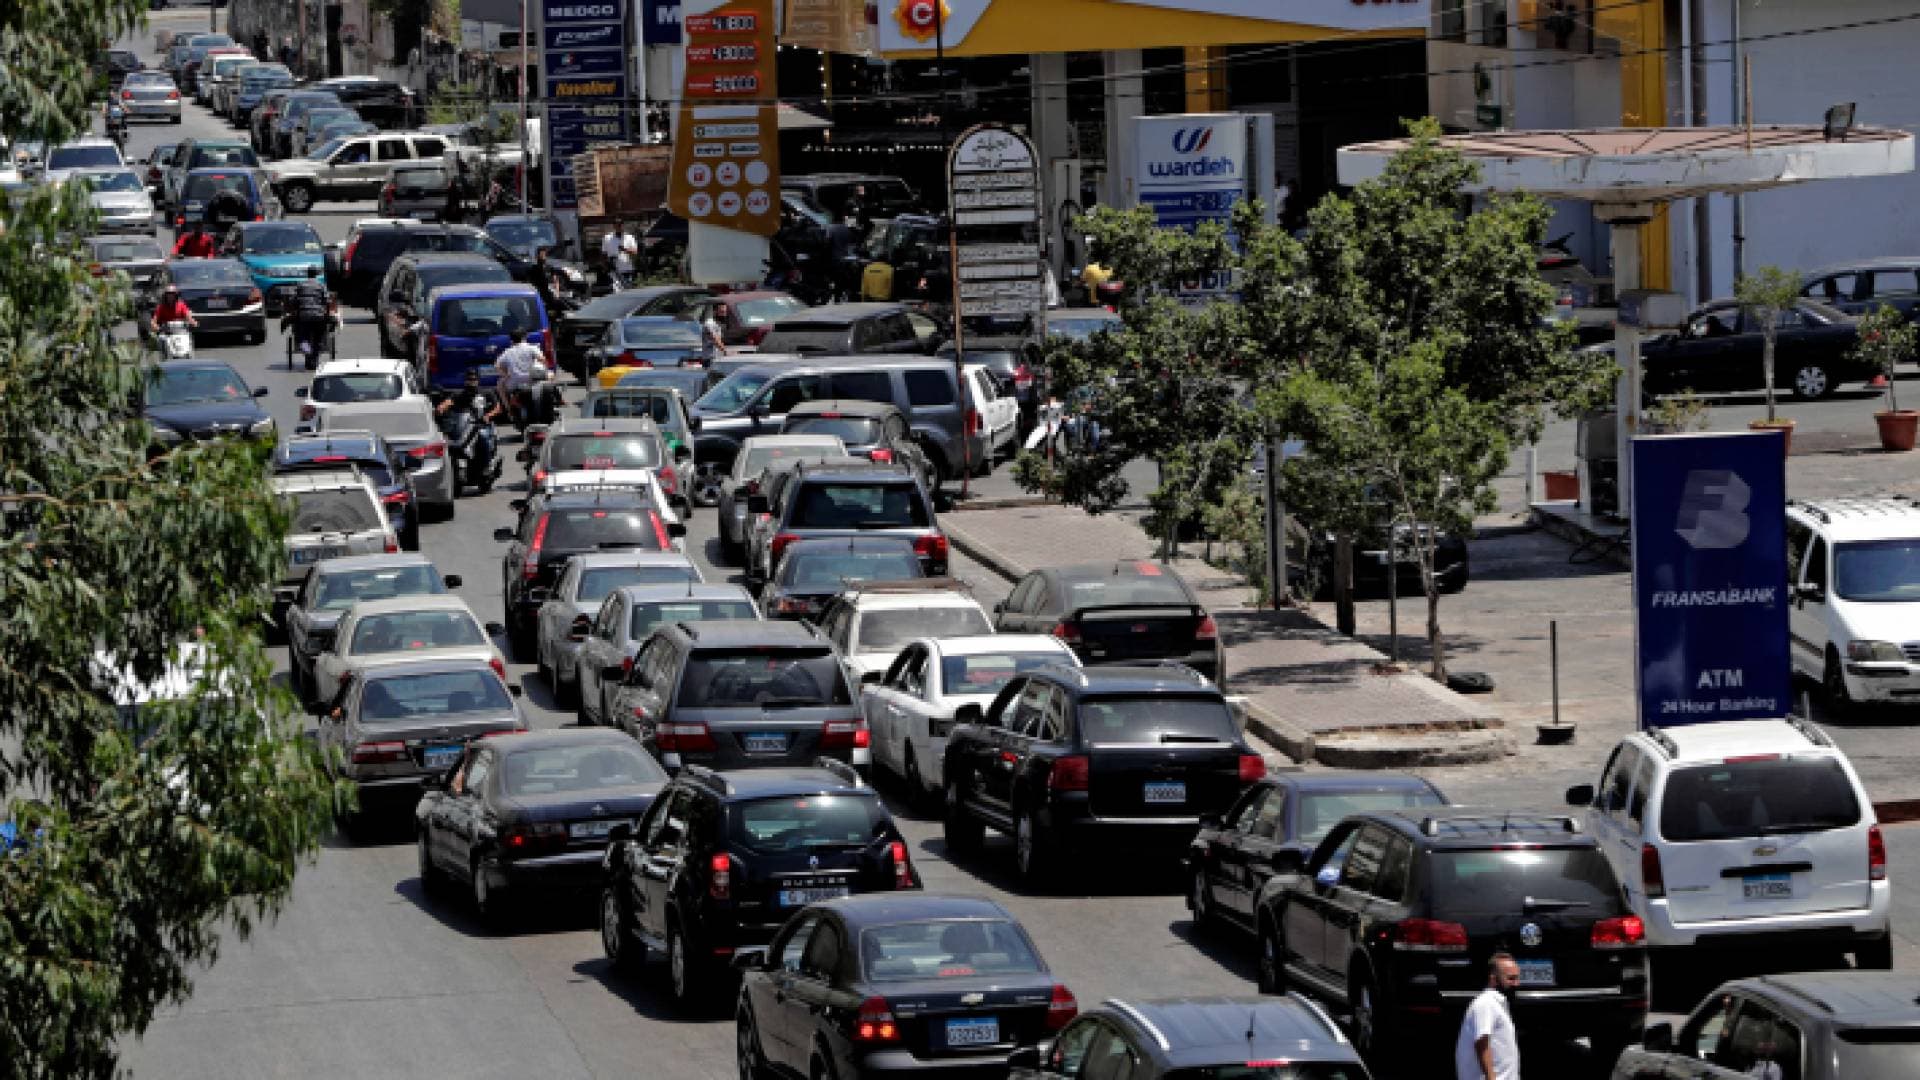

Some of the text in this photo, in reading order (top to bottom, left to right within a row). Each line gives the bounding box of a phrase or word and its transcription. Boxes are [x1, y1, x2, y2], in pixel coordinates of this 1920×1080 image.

[1149, 156, 1235, 176] wardieh
[1652, 588, 1775, 607] FRANSABANK
[1698, 669, 1743, 689] ATM
[1661, 696, 1776, 713] 24 Hour Banking
